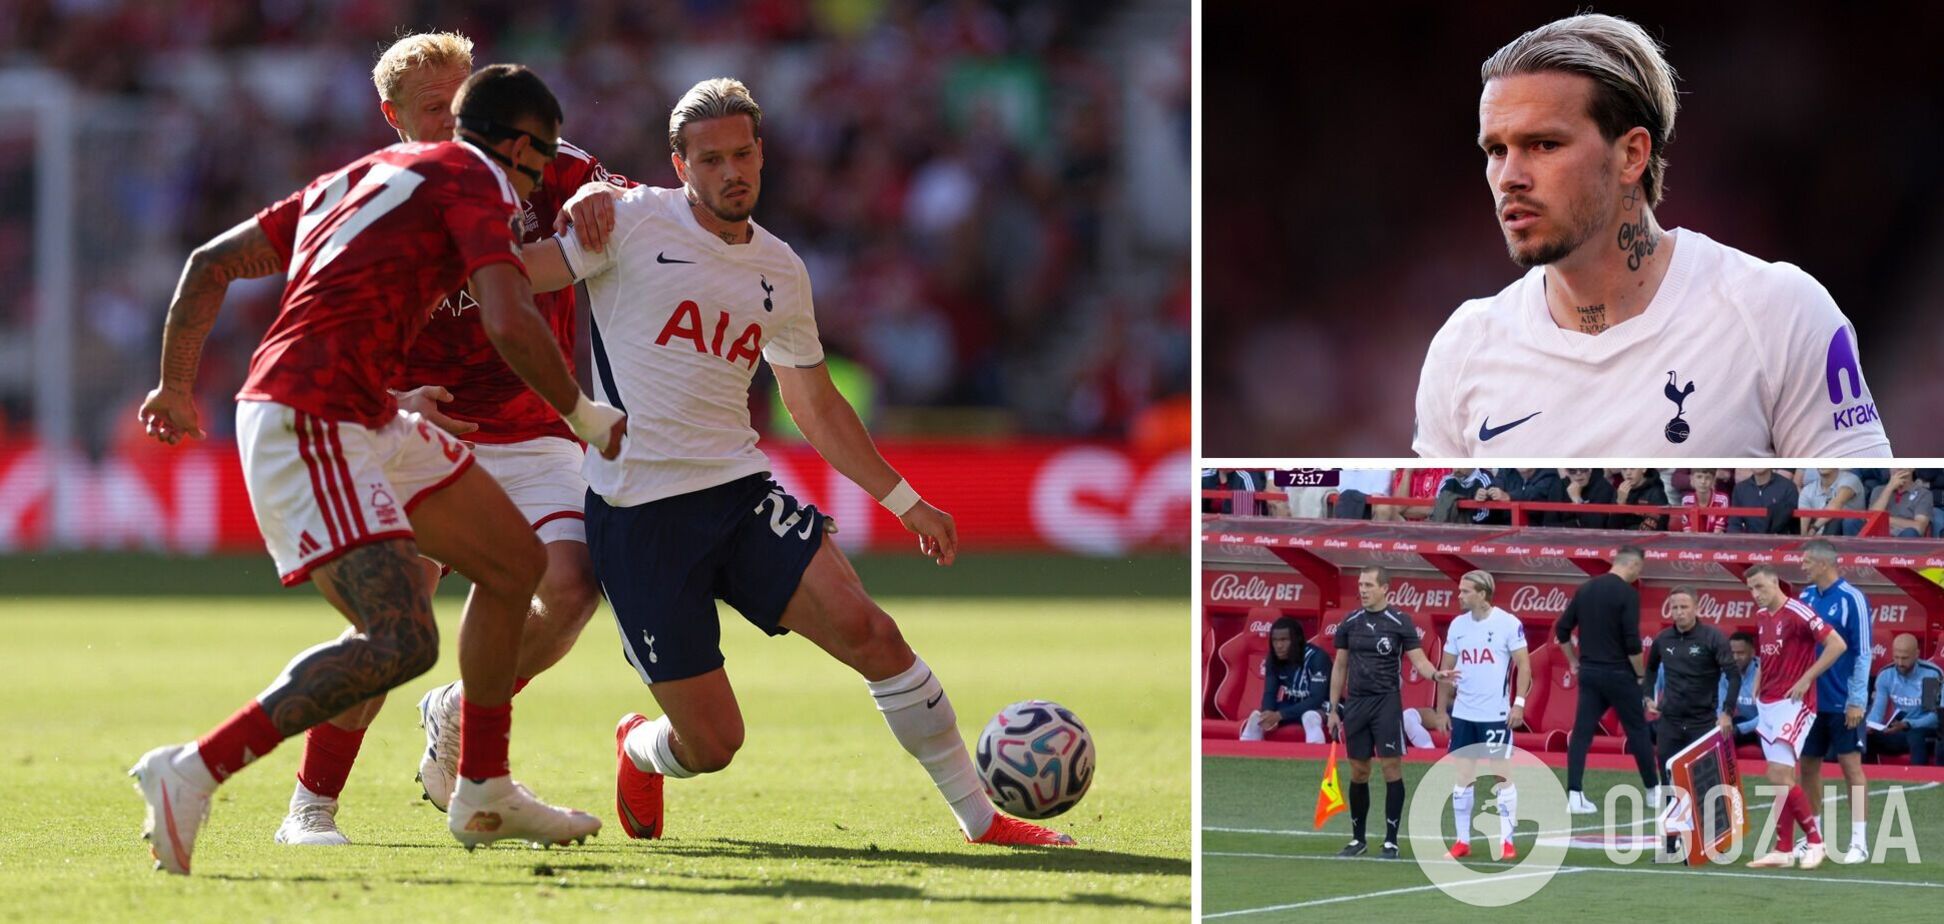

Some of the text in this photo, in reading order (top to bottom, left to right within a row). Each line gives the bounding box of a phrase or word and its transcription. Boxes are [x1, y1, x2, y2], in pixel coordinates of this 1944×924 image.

[654, 299, 763, 371] AIA
[1210, 574, 1303, 607] Bally BET
[1386, 582, 1453, 612] ally BET
[1726, 601, 1754, 618] BET
[1879, 605, 1908, 622] BET
[1461, 648, 1495, 664] AIA
[1781, 722, 1793, 736] 9
[1486, 729, 1506, 747] 27
